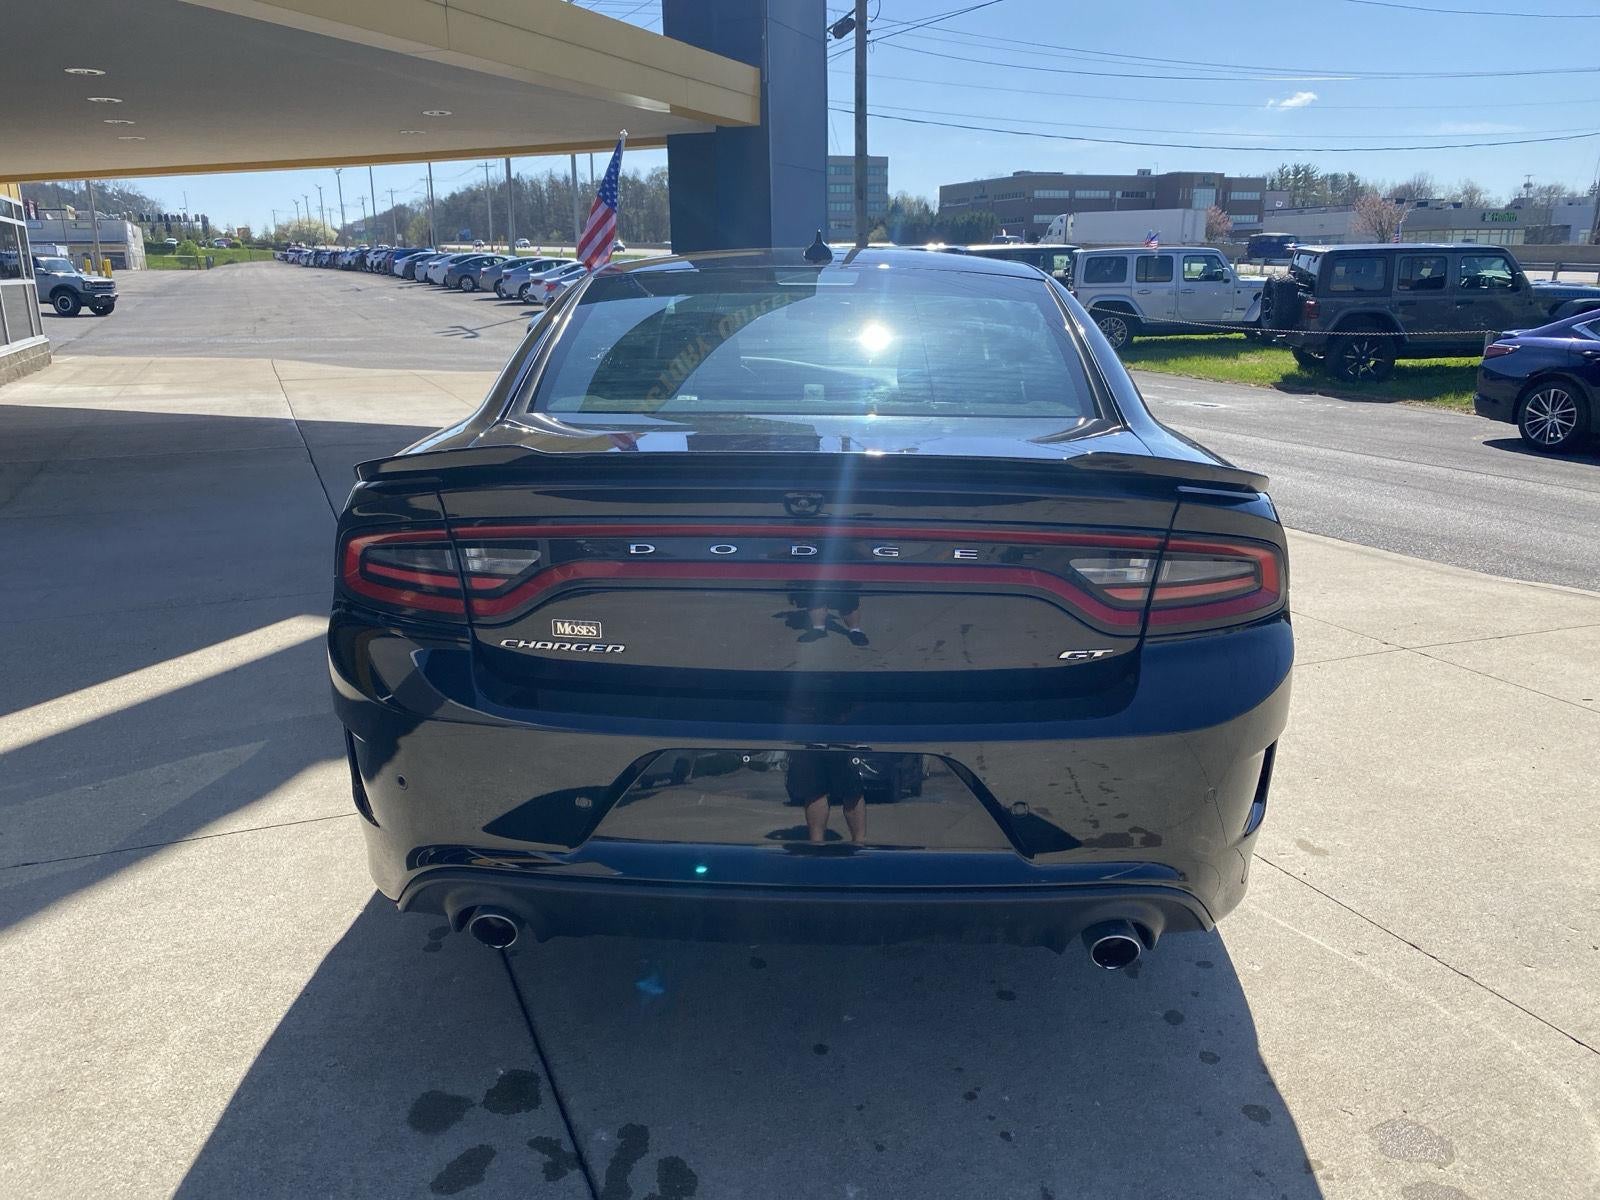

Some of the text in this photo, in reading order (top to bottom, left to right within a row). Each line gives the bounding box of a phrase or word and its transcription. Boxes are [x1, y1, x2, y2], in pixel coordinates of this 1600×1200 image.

[629, 543, 979, 560] DODGE
[556, 621, 598, 637] MOSES
[500, 638, 626, 655] CHARGER
[1058, 649, 1113, 660] GT
